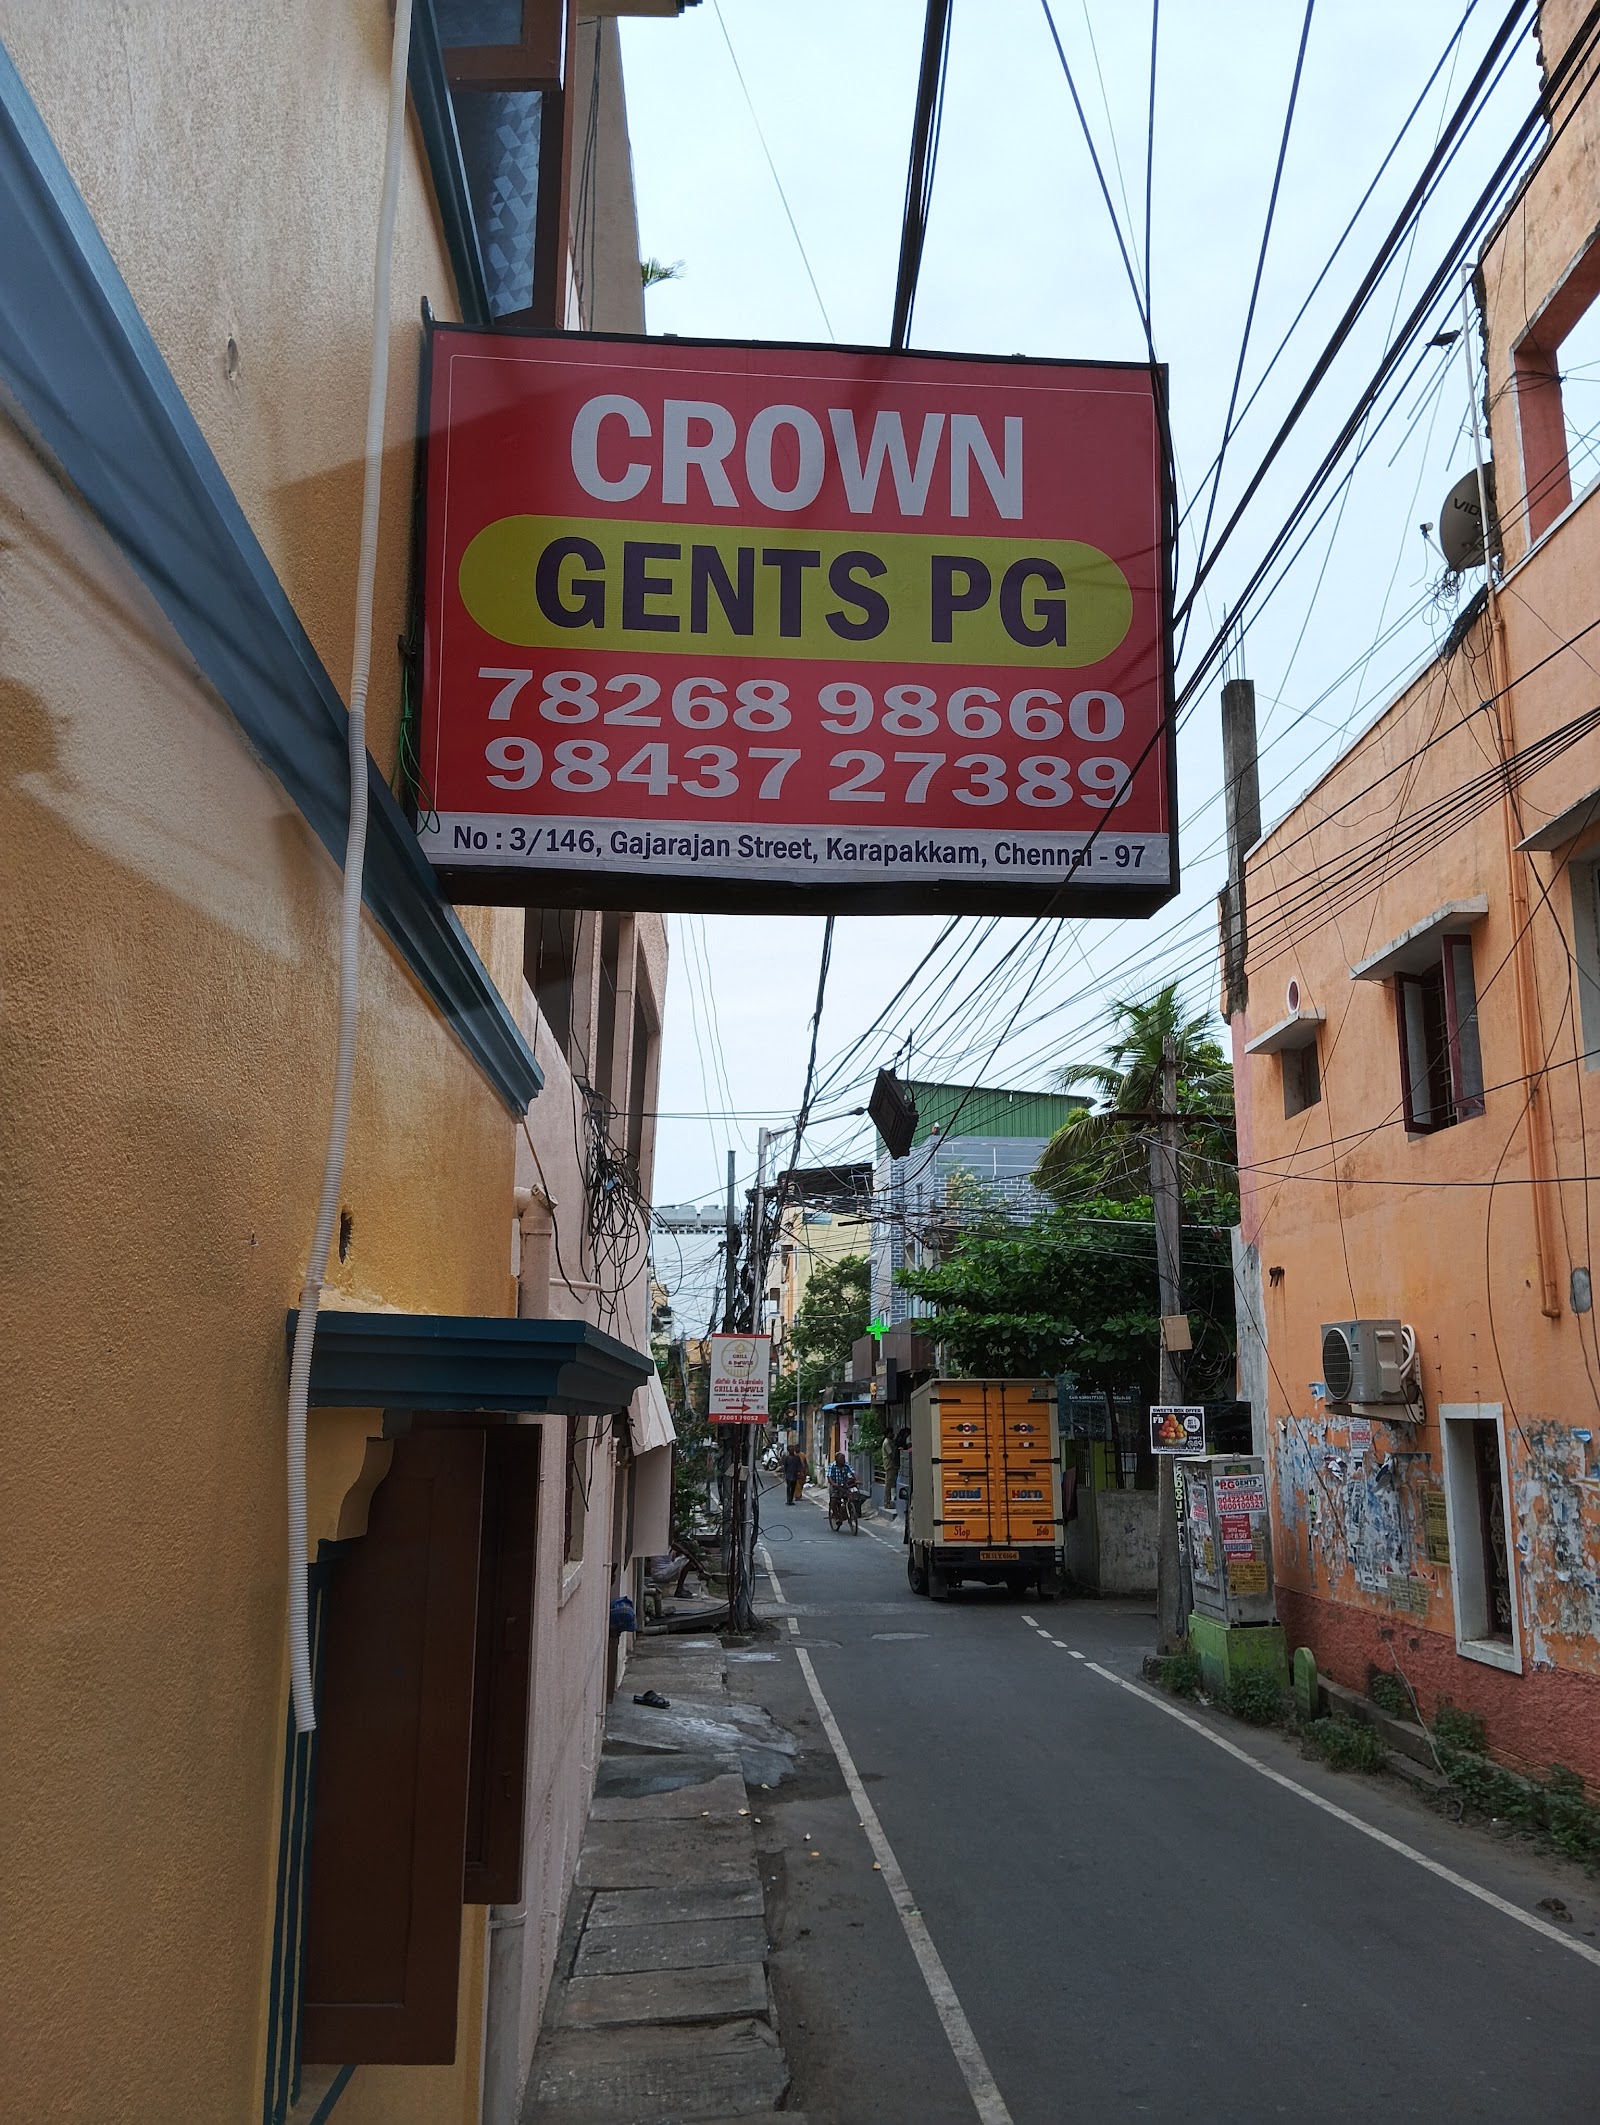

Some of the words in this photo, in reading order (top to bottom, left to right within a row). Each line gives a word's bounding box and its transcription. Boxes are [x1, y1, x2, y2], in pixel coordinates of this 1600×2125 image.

[570, 394, 1025, 520] CROWN
[534, 536, 890, 643] GENTS
[929, 554, 1068, 648] PG
[477, 667, 793, 731] 78268
[818, 683, 1126, 742] 98660
[484, 736, 802, 801] 98437
[828, 749, 1133, 808] 27389
[509, 827, 602, 857] 3/146,
[610, 830, 730, 862] Gajarajan
[737, 834, 818, 864] Street,
[826, 837, 987, 869] Karapakkam,
[994, 842, 1092, 867] Chennai
[1114, 844, 1146, 868] 97
[1012, 1489, 1043, 1499] Horn
[954, 1526, 970, 1538] Stop
